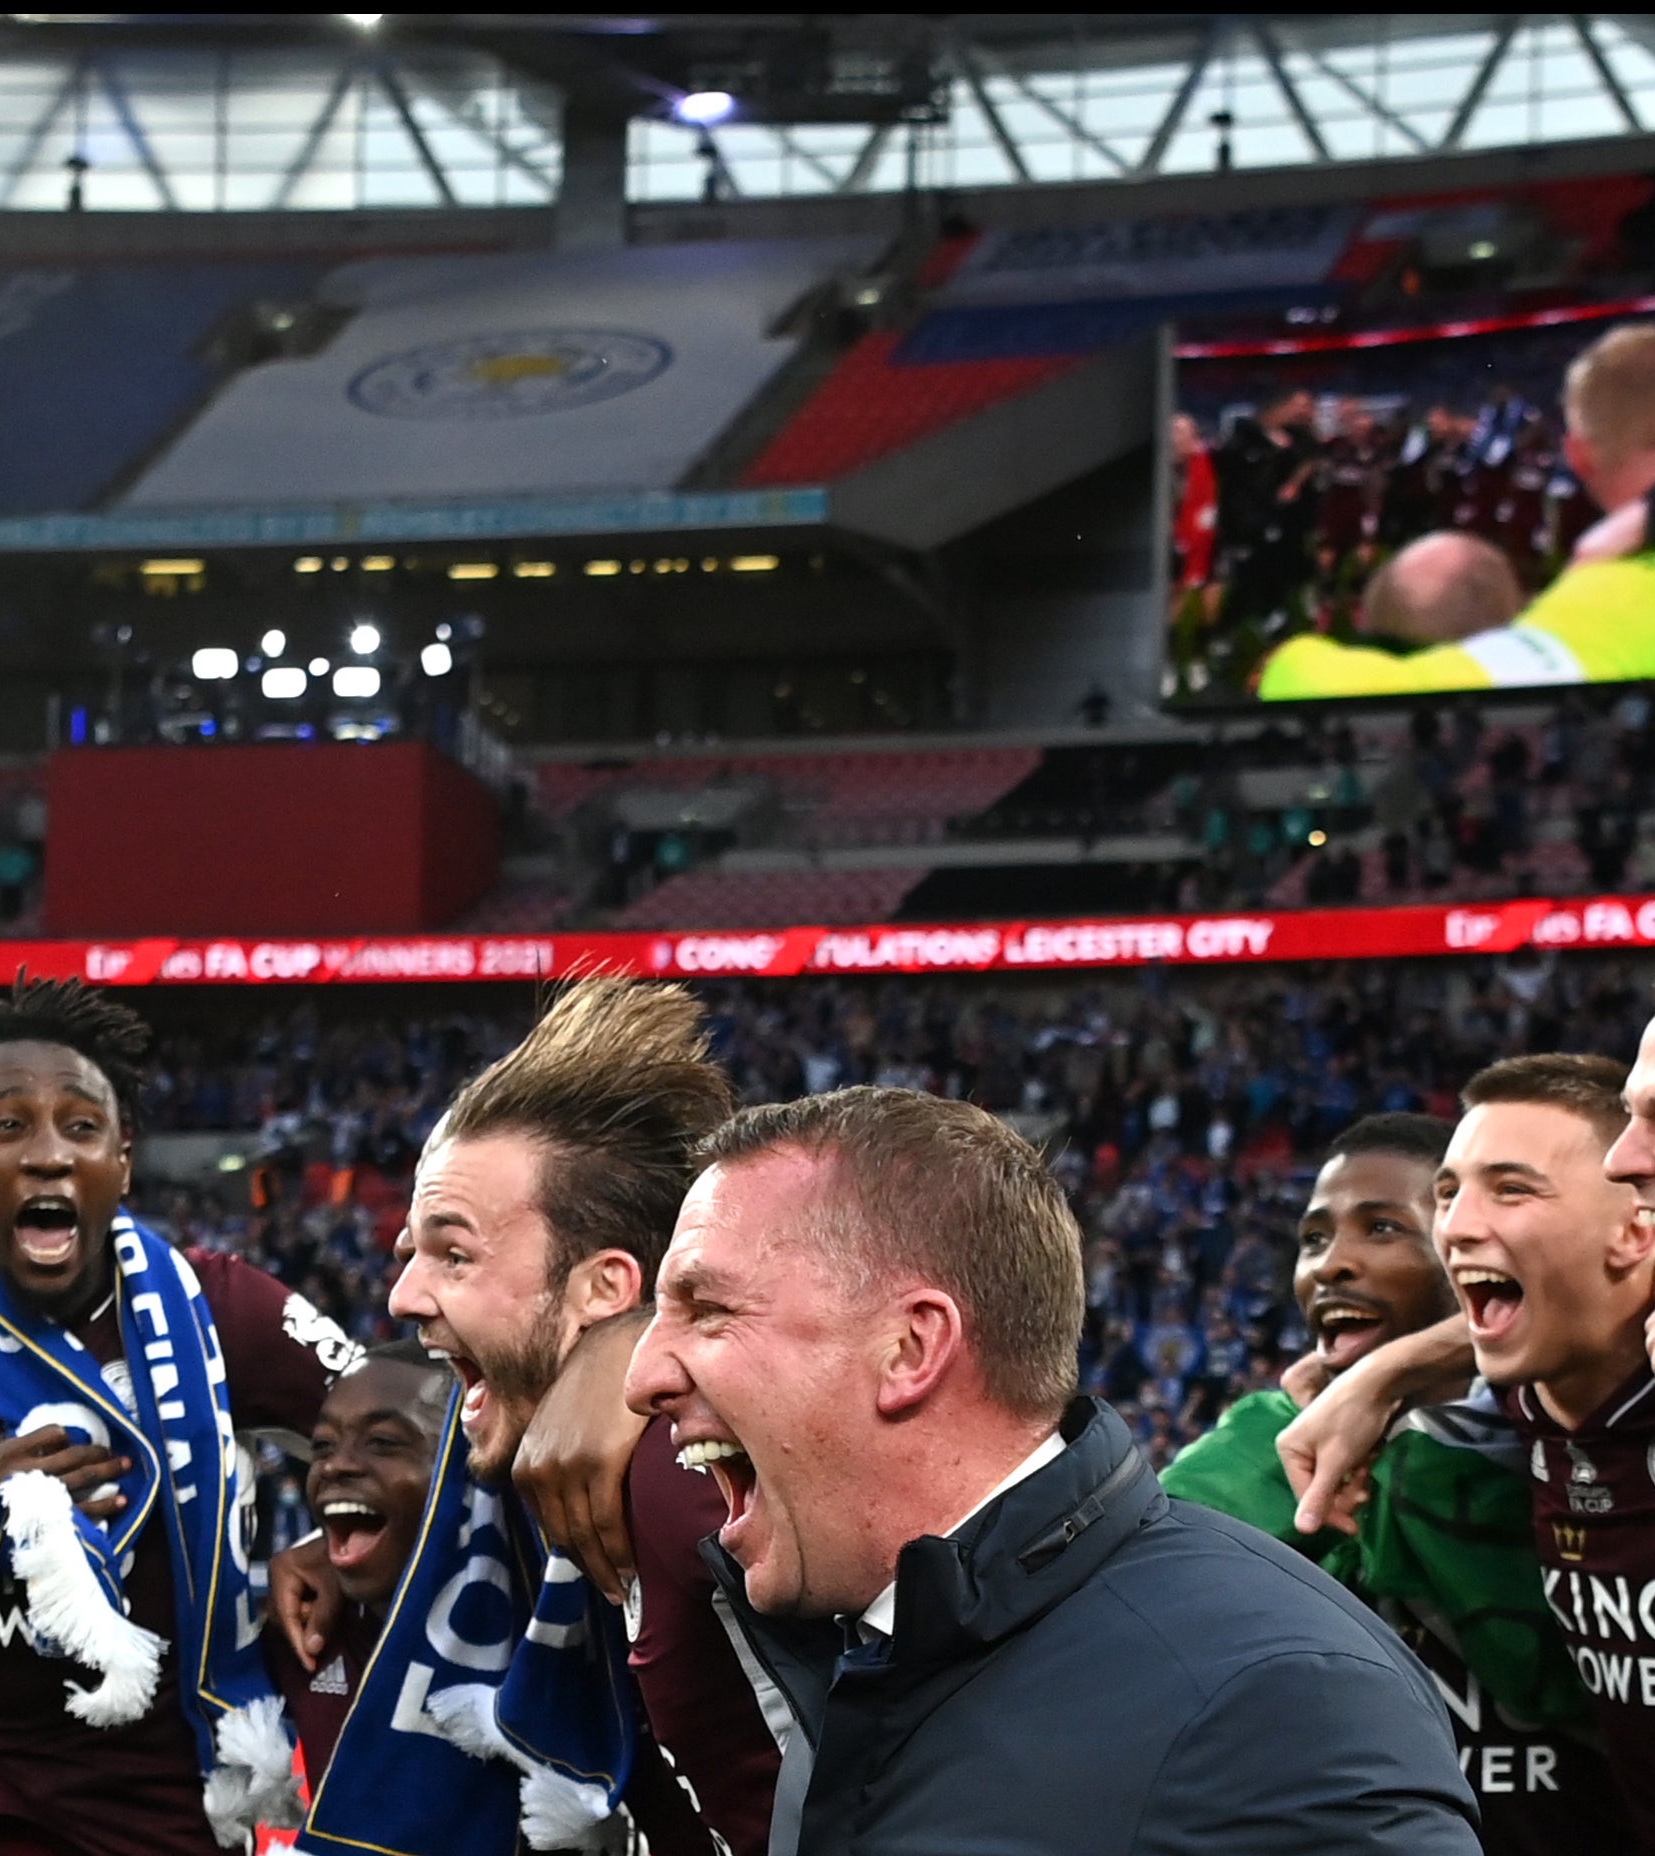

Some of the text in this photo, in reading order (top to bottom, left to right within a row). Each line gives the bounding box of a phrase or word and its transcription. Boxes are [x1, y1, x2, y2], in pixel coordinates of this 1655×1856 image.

[251, 942, 321, 978] CUP
[1004, 922, 1183, 963] LEICESTER
[1186, 919, 1274, 958] CITY
